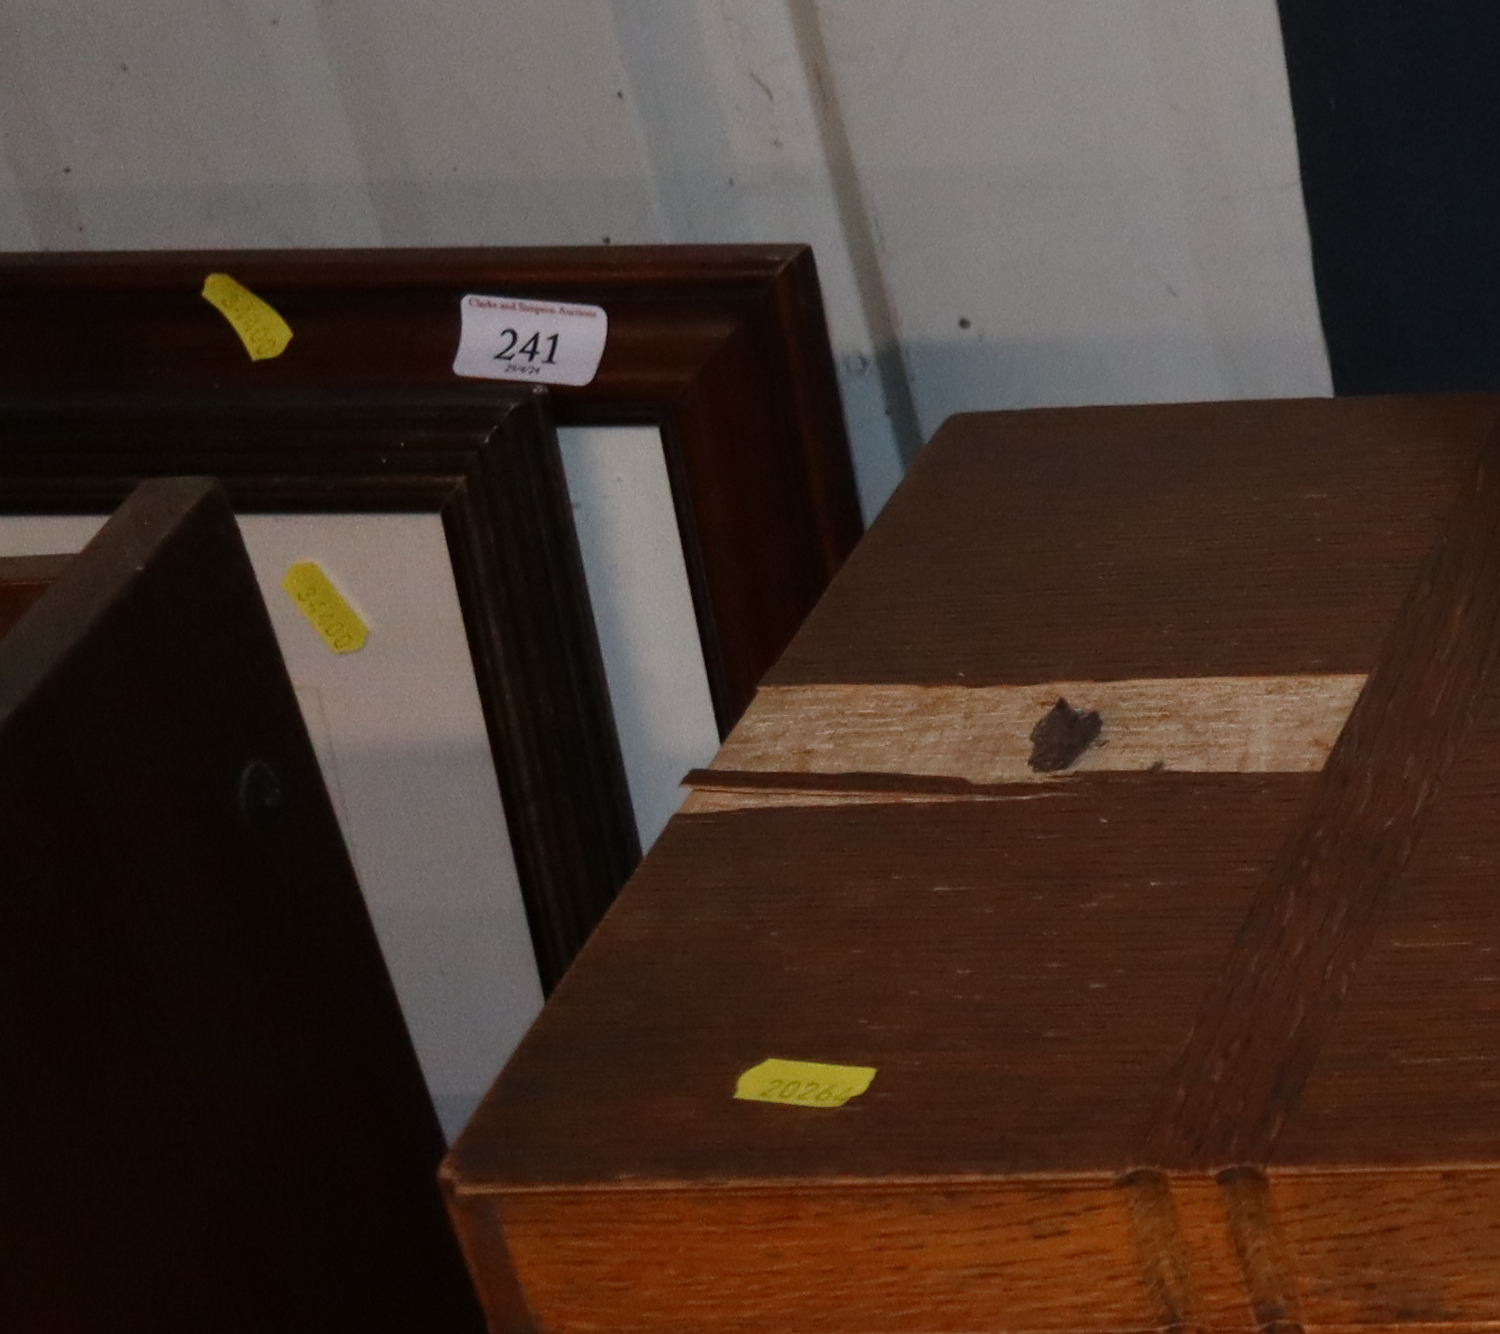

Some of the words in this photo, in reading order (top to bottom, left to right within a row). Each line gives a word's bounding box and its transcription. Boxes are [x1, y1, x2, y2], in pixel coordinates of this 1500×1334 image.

[468, 298, 498, 310] Clarke
[500, 302, 517, 312] and
[518, 303, 556, 315] Simpson
[558, 307, 597, 318] Auctions
[494, 328, 560, 364] 241
